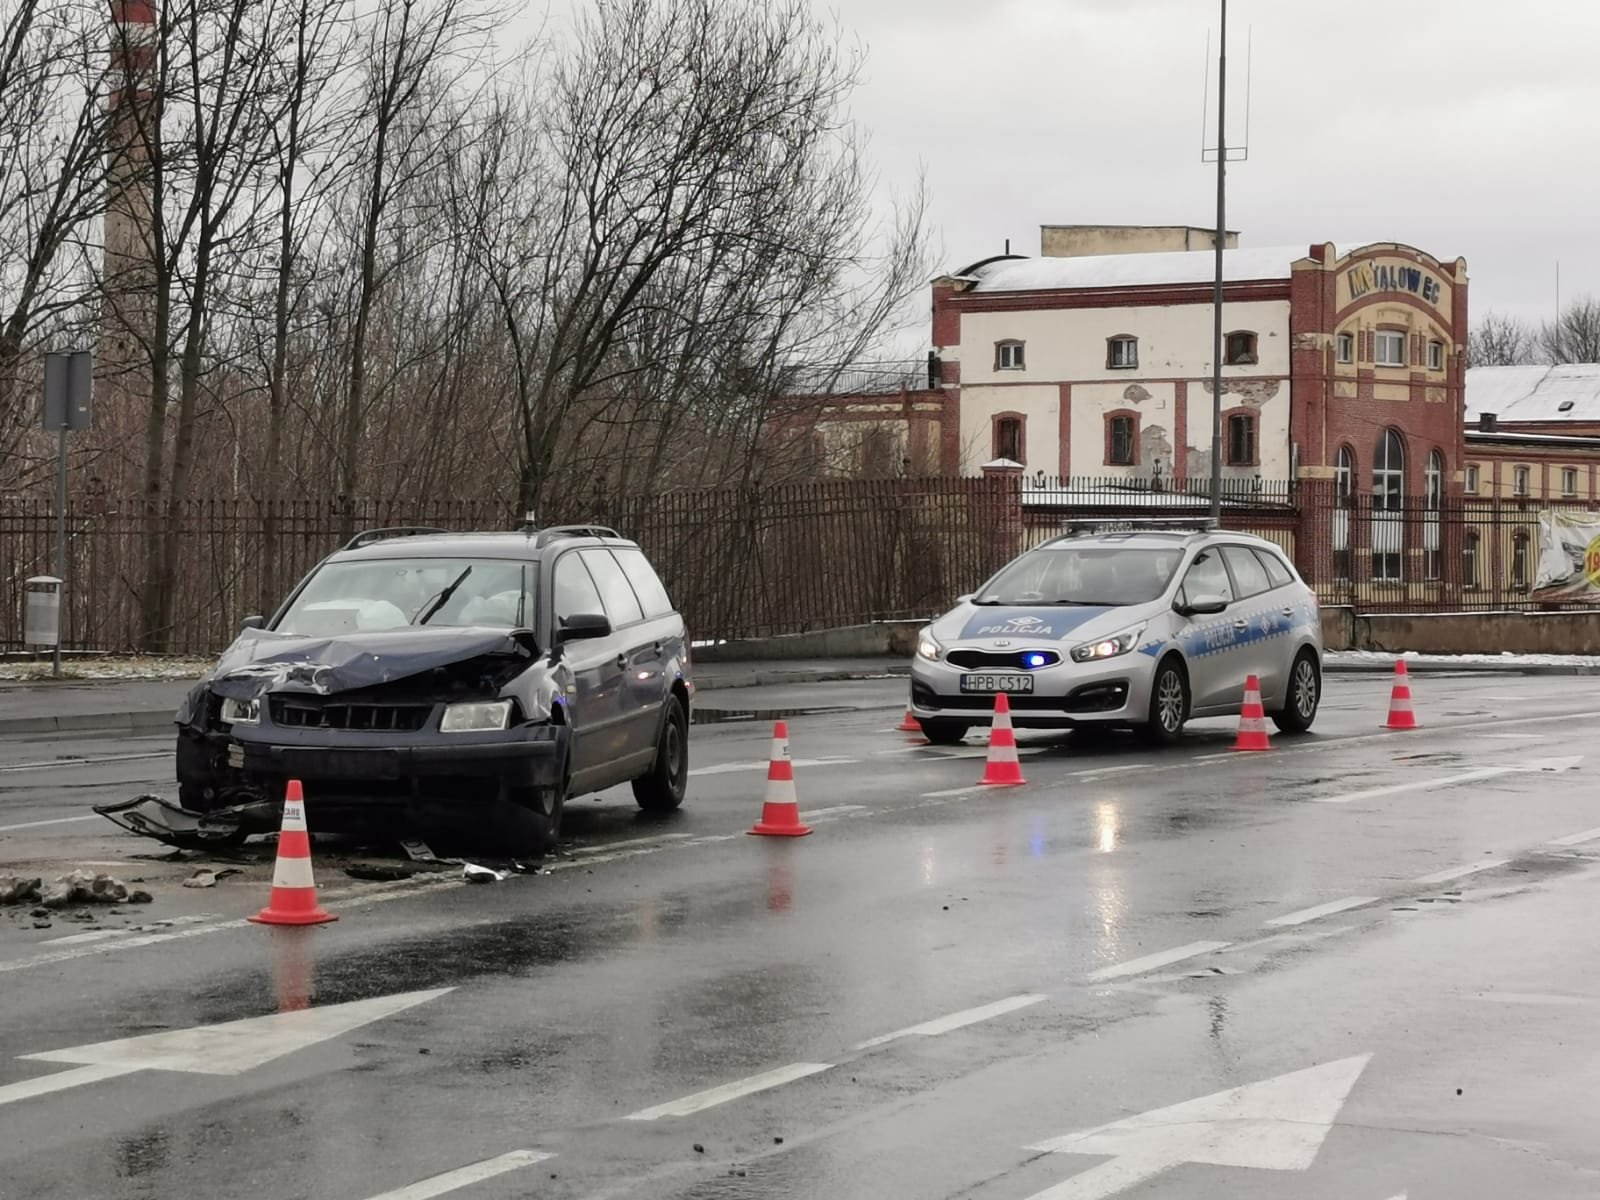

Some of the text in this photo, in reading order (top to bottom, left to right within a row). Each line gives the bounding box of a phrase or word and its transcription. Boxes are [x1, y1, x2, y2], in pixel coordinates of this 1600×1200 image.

[977, 625, 1053, 635] POLICJA
[968, 676, 995, 690] HPB
[999, 676, 1031, 690] C512
